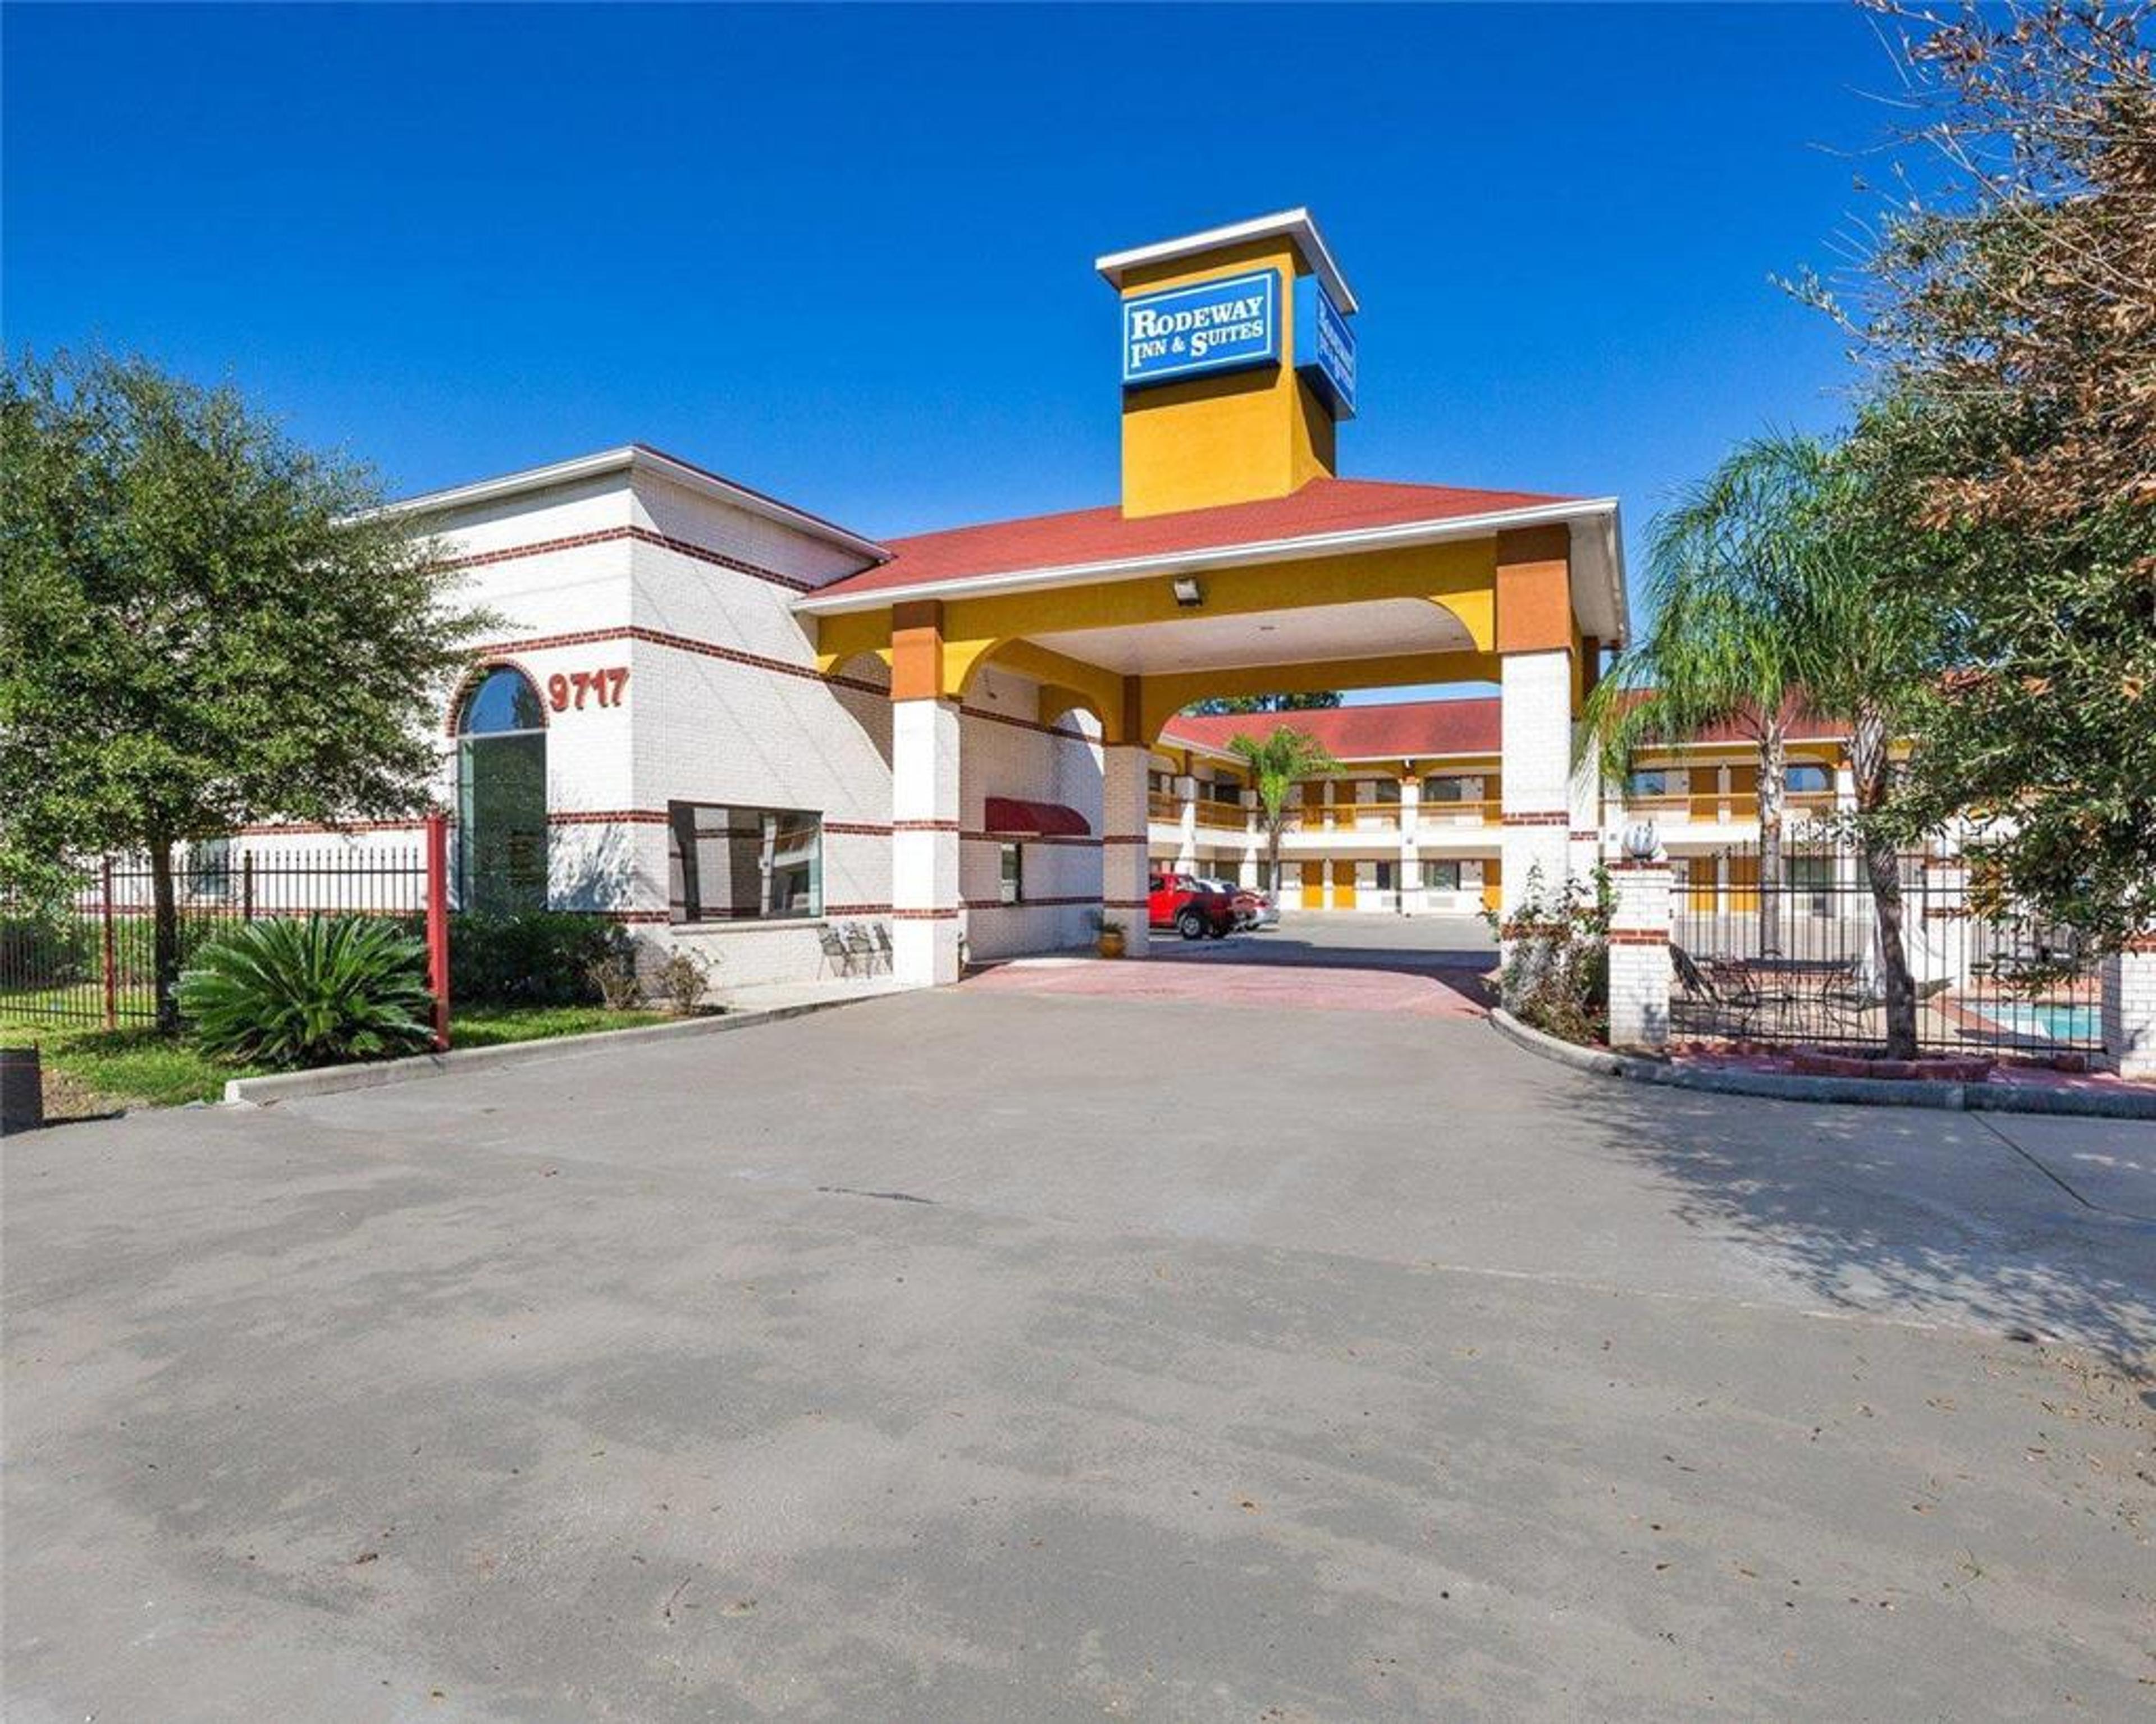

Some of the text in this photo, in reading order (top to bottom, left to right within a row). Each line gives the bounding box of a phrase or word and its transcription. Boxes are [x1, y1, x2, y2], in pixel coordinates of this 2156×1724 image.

[1131, 296, 1264, 340] RODEWAY
[1131, 320, 1264, 368] INN & SUITES
[549, 667, 630, 712] 9717
